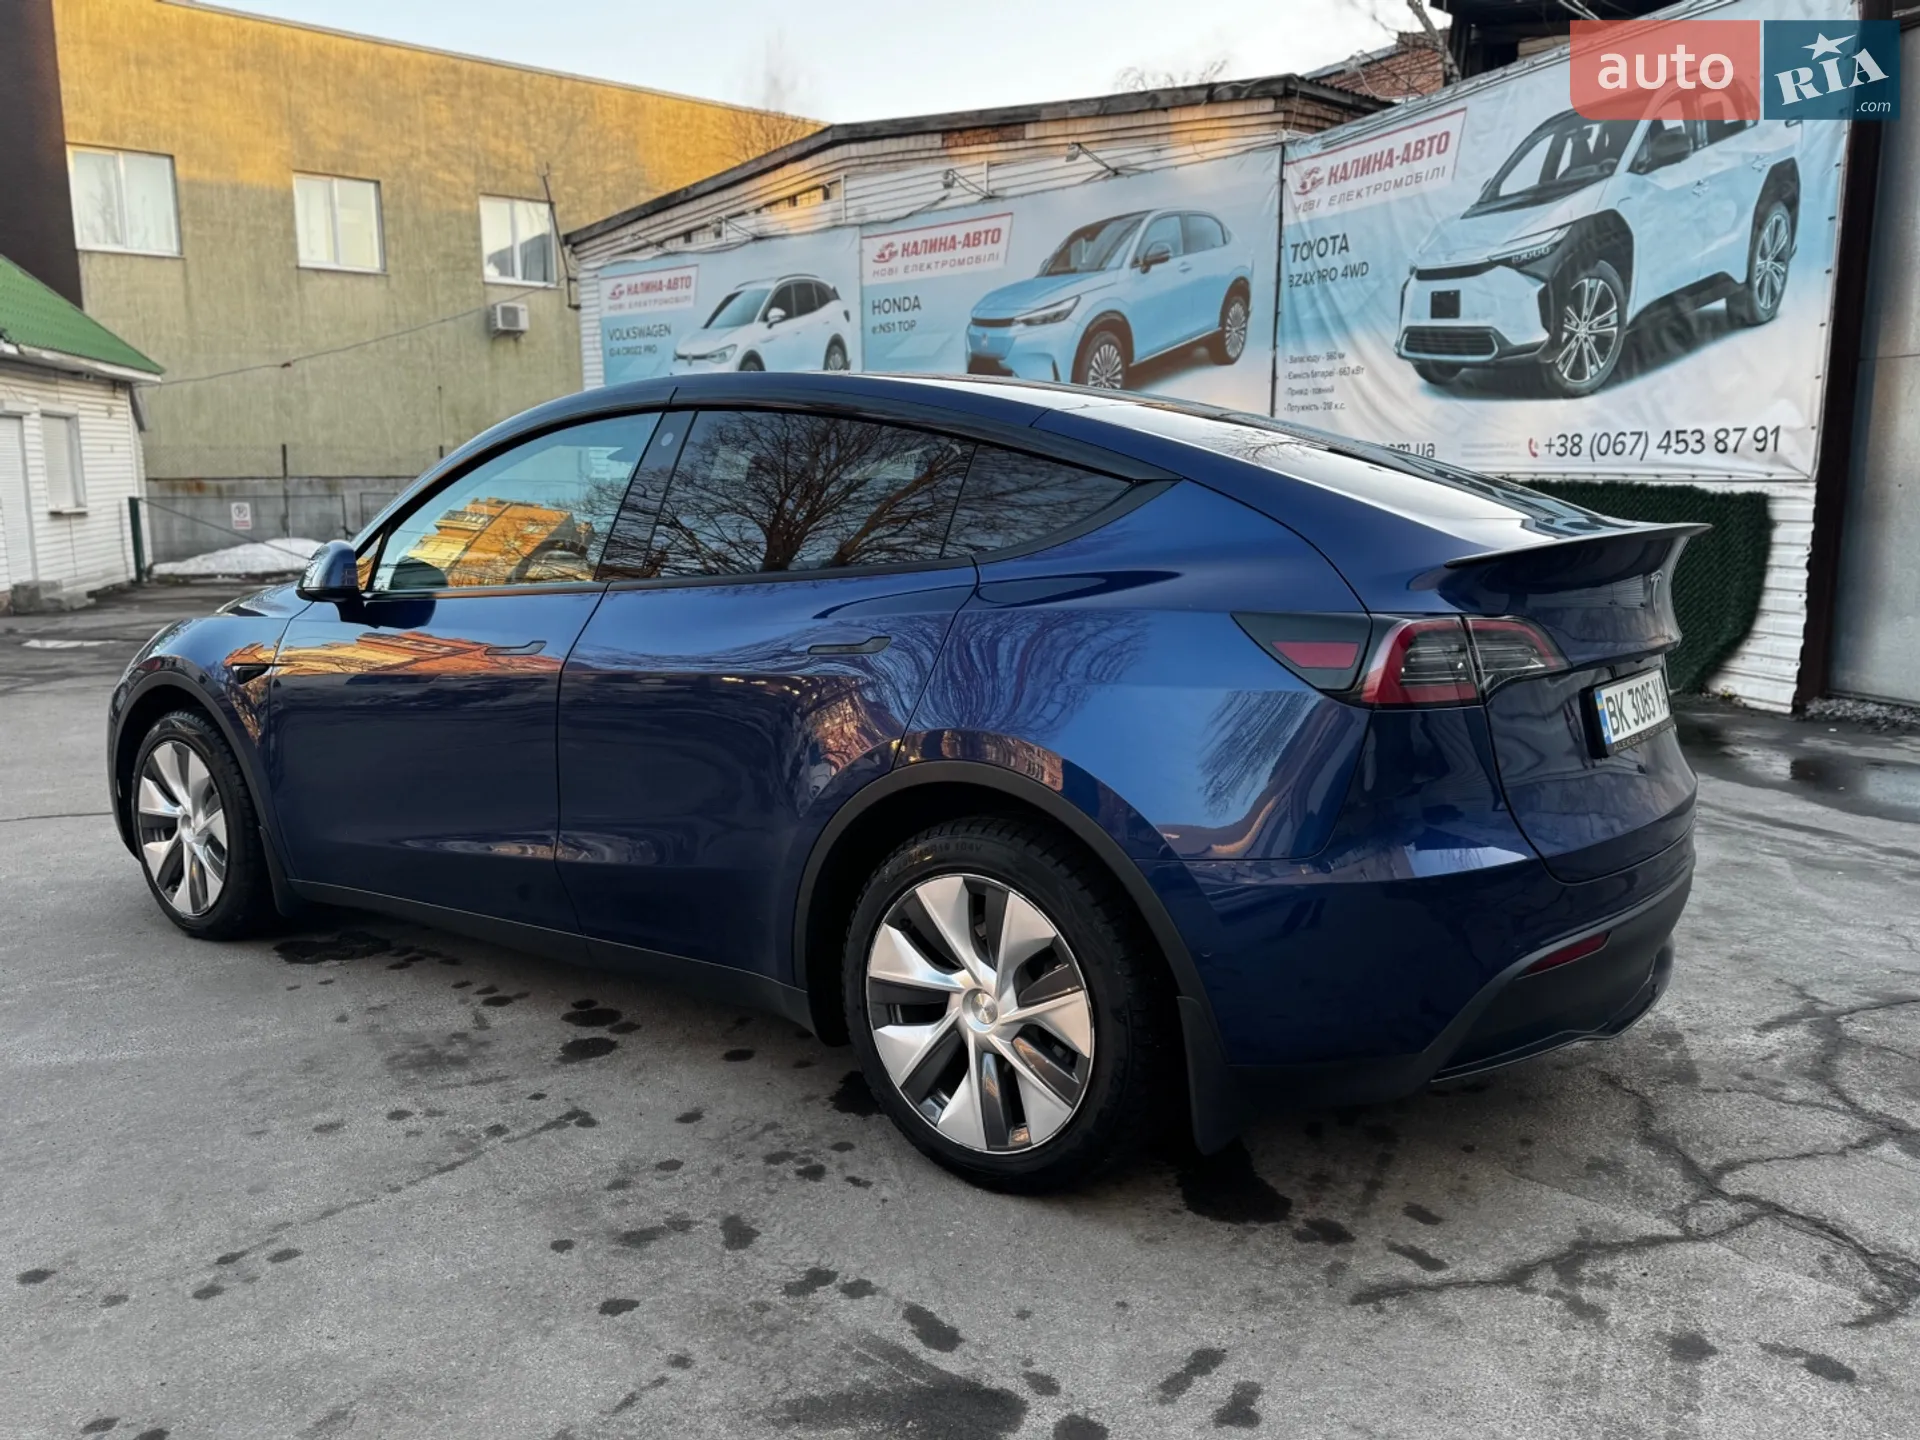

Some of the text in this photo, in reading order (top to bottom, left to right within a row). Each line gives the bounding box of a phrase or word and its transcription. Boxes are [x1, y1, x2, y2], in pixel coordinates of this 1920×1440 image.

[1327, 130, 1450, 186] КАЛИНА-АВТО
[1328, 165, 1446, 207] ЕЛЕКТРОМОБІЛІ
[901, 227, 1002, 258] КАЛИНА-АВТО
[1291, 232, 1350, 263] TOYOTA
[872, 252, 1000, 278] НОВІ ЕЛЕКТРОМОБІЛІ
[1341, 261, 1369, 279] 4WD
[626, 275, 692, 296] КАЛИНА-АВТО
[872, 295, 922, 315] HONDA
[608, 322, 672, 341] VOLKSWAGEN
[898, 320, 917, 333] TOP
[1544, 432, 1582, 457] +38
[1589, 430, 1649, 462] (067)
[1657, 428, 1706, 455] 453
[1714, 426, 1747, 453] 87
[1753, 424, 1781, 452] 91
[1605, 691, 1631, 737] BK
